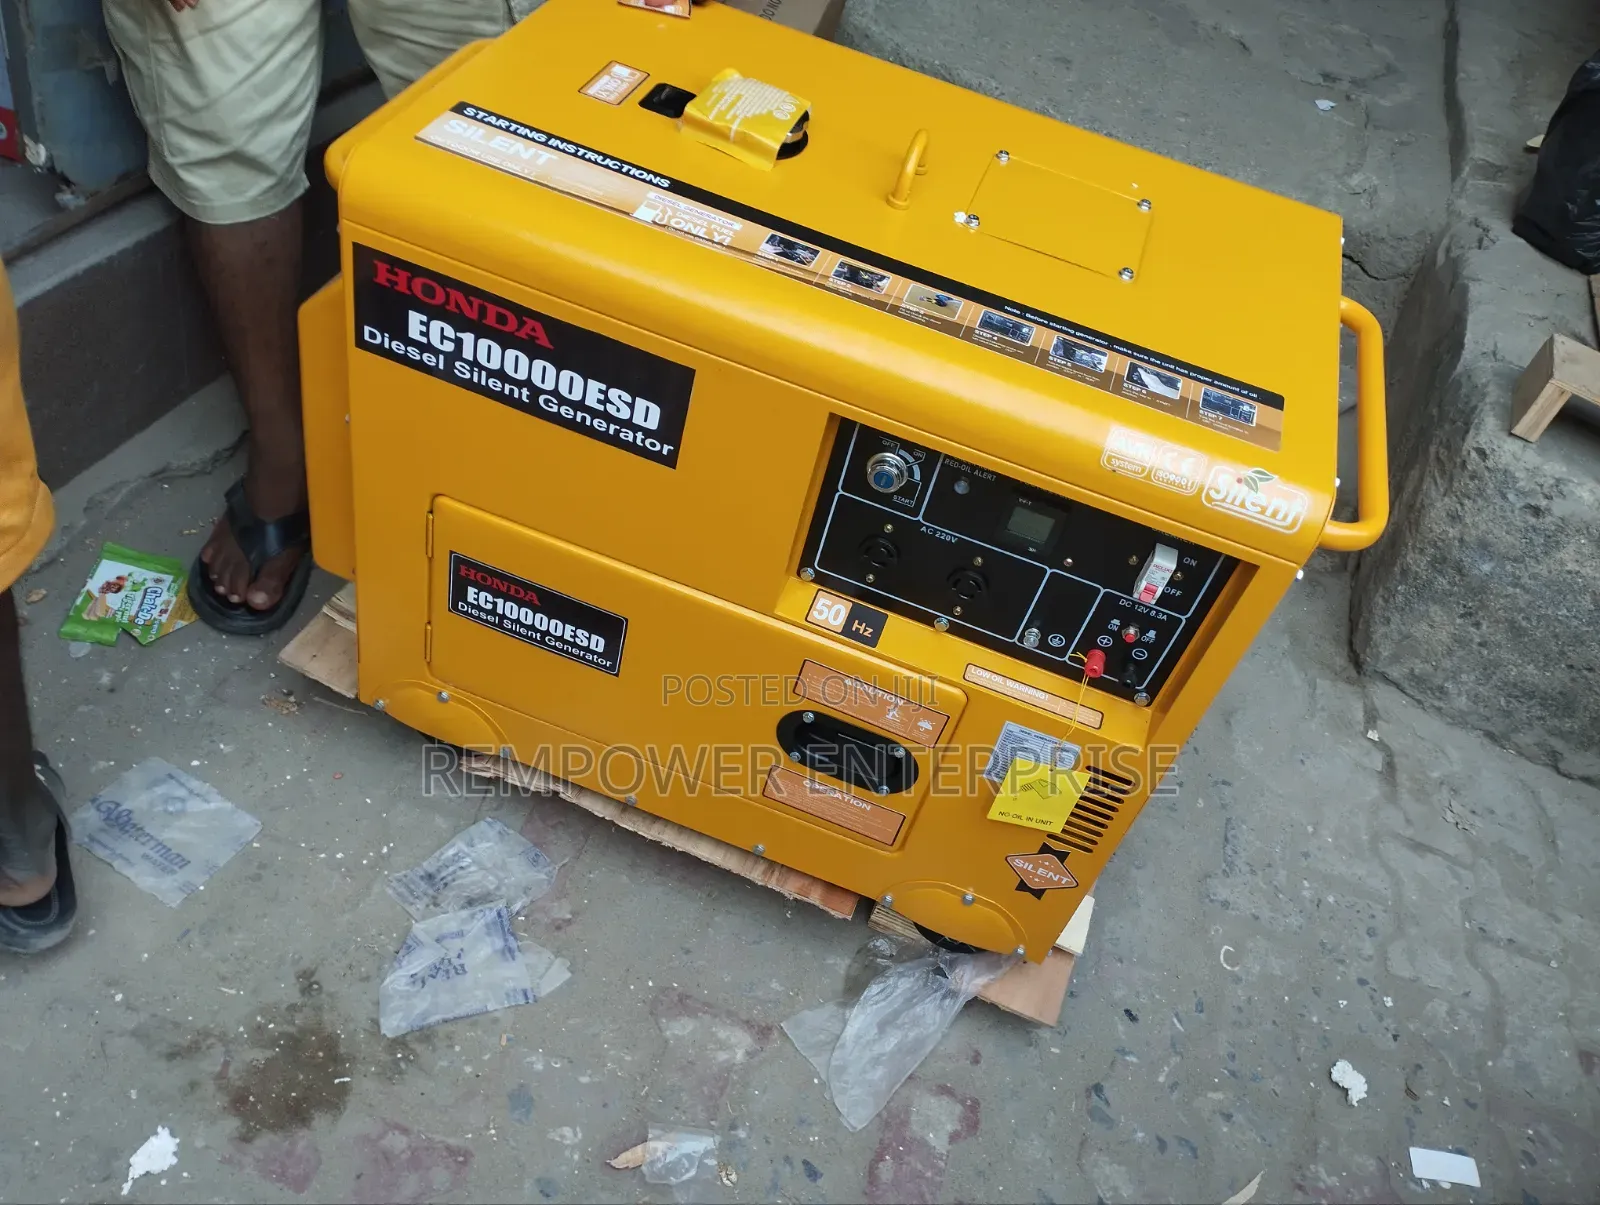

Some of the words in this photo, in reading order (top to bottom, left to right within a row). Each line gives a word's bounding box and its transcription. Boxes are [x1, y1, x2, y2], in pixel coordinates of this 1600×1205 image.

[443, 119, 560, 166] SILENT
[463, 107, 546, 142] STARTING
[548, 136, 671, 188] INSTRUCTIONS
[676, 211, 709, 227] DIESEL
[711, 223, 736, 237] FUEL
[683, 205, 735, 227] GENERATOR
[670, 217, 733, 246] ONLY!
[372, 259, 554, 350] HONDA
[408, 309, 661, 432] EC10000ESD
[1075, 331, 1109, 346] generator
[1113, 344, 1132, 355] make
[1189, 371, 1213, 384] proper
[363, 325, 445, 369] Diesel
[454, 359, 530, 402] Silent
[538, 391, 674, 457] Generator
[944, 458, 971, 473] RED-OIL
[974, 470, 997, 482] ALERT
[1111, 458, 1142, 474] system
[893, 495, 914, 506] START
[1208, 472, 1304, 525] Silent
[920, 526, 934, 535] AC
[935, 531, 958, 544] 220V
[1183, 556, 1198, 567] ON
[458, 564, 541, 606] HONDA
[1164, 586, 1182, 597] OFF
[467, 585, 605, 653] EC10000ESD
[812, 597, 846, 626] 50
[852, 619, 874, 638] Hz
[1119, 598, 1132, 608] DC
[1135, 604, 1150, 614] 12V
[1150, 610, 1167, 621] 8.3A
[458, 601, 499, 624] Diesel
[503, 619, 542, 641] Silent
[545, 635, 612, 667] Generator
[1108, 623, 1119, 631] ON
[1141, 636, 1155, 644] OFF
[852, 680, 904, 706] CAUTION
[971, 666, 990, 679] LOW
[991, 674, 1005, 685] OIL
[1006, 679, 1049, 701] WARNING!
[802, 779, 871, 811] OPERATION
[1035, 818, 1054, 826] UNIT
[1013, 858, 1072, 885] SILENT
